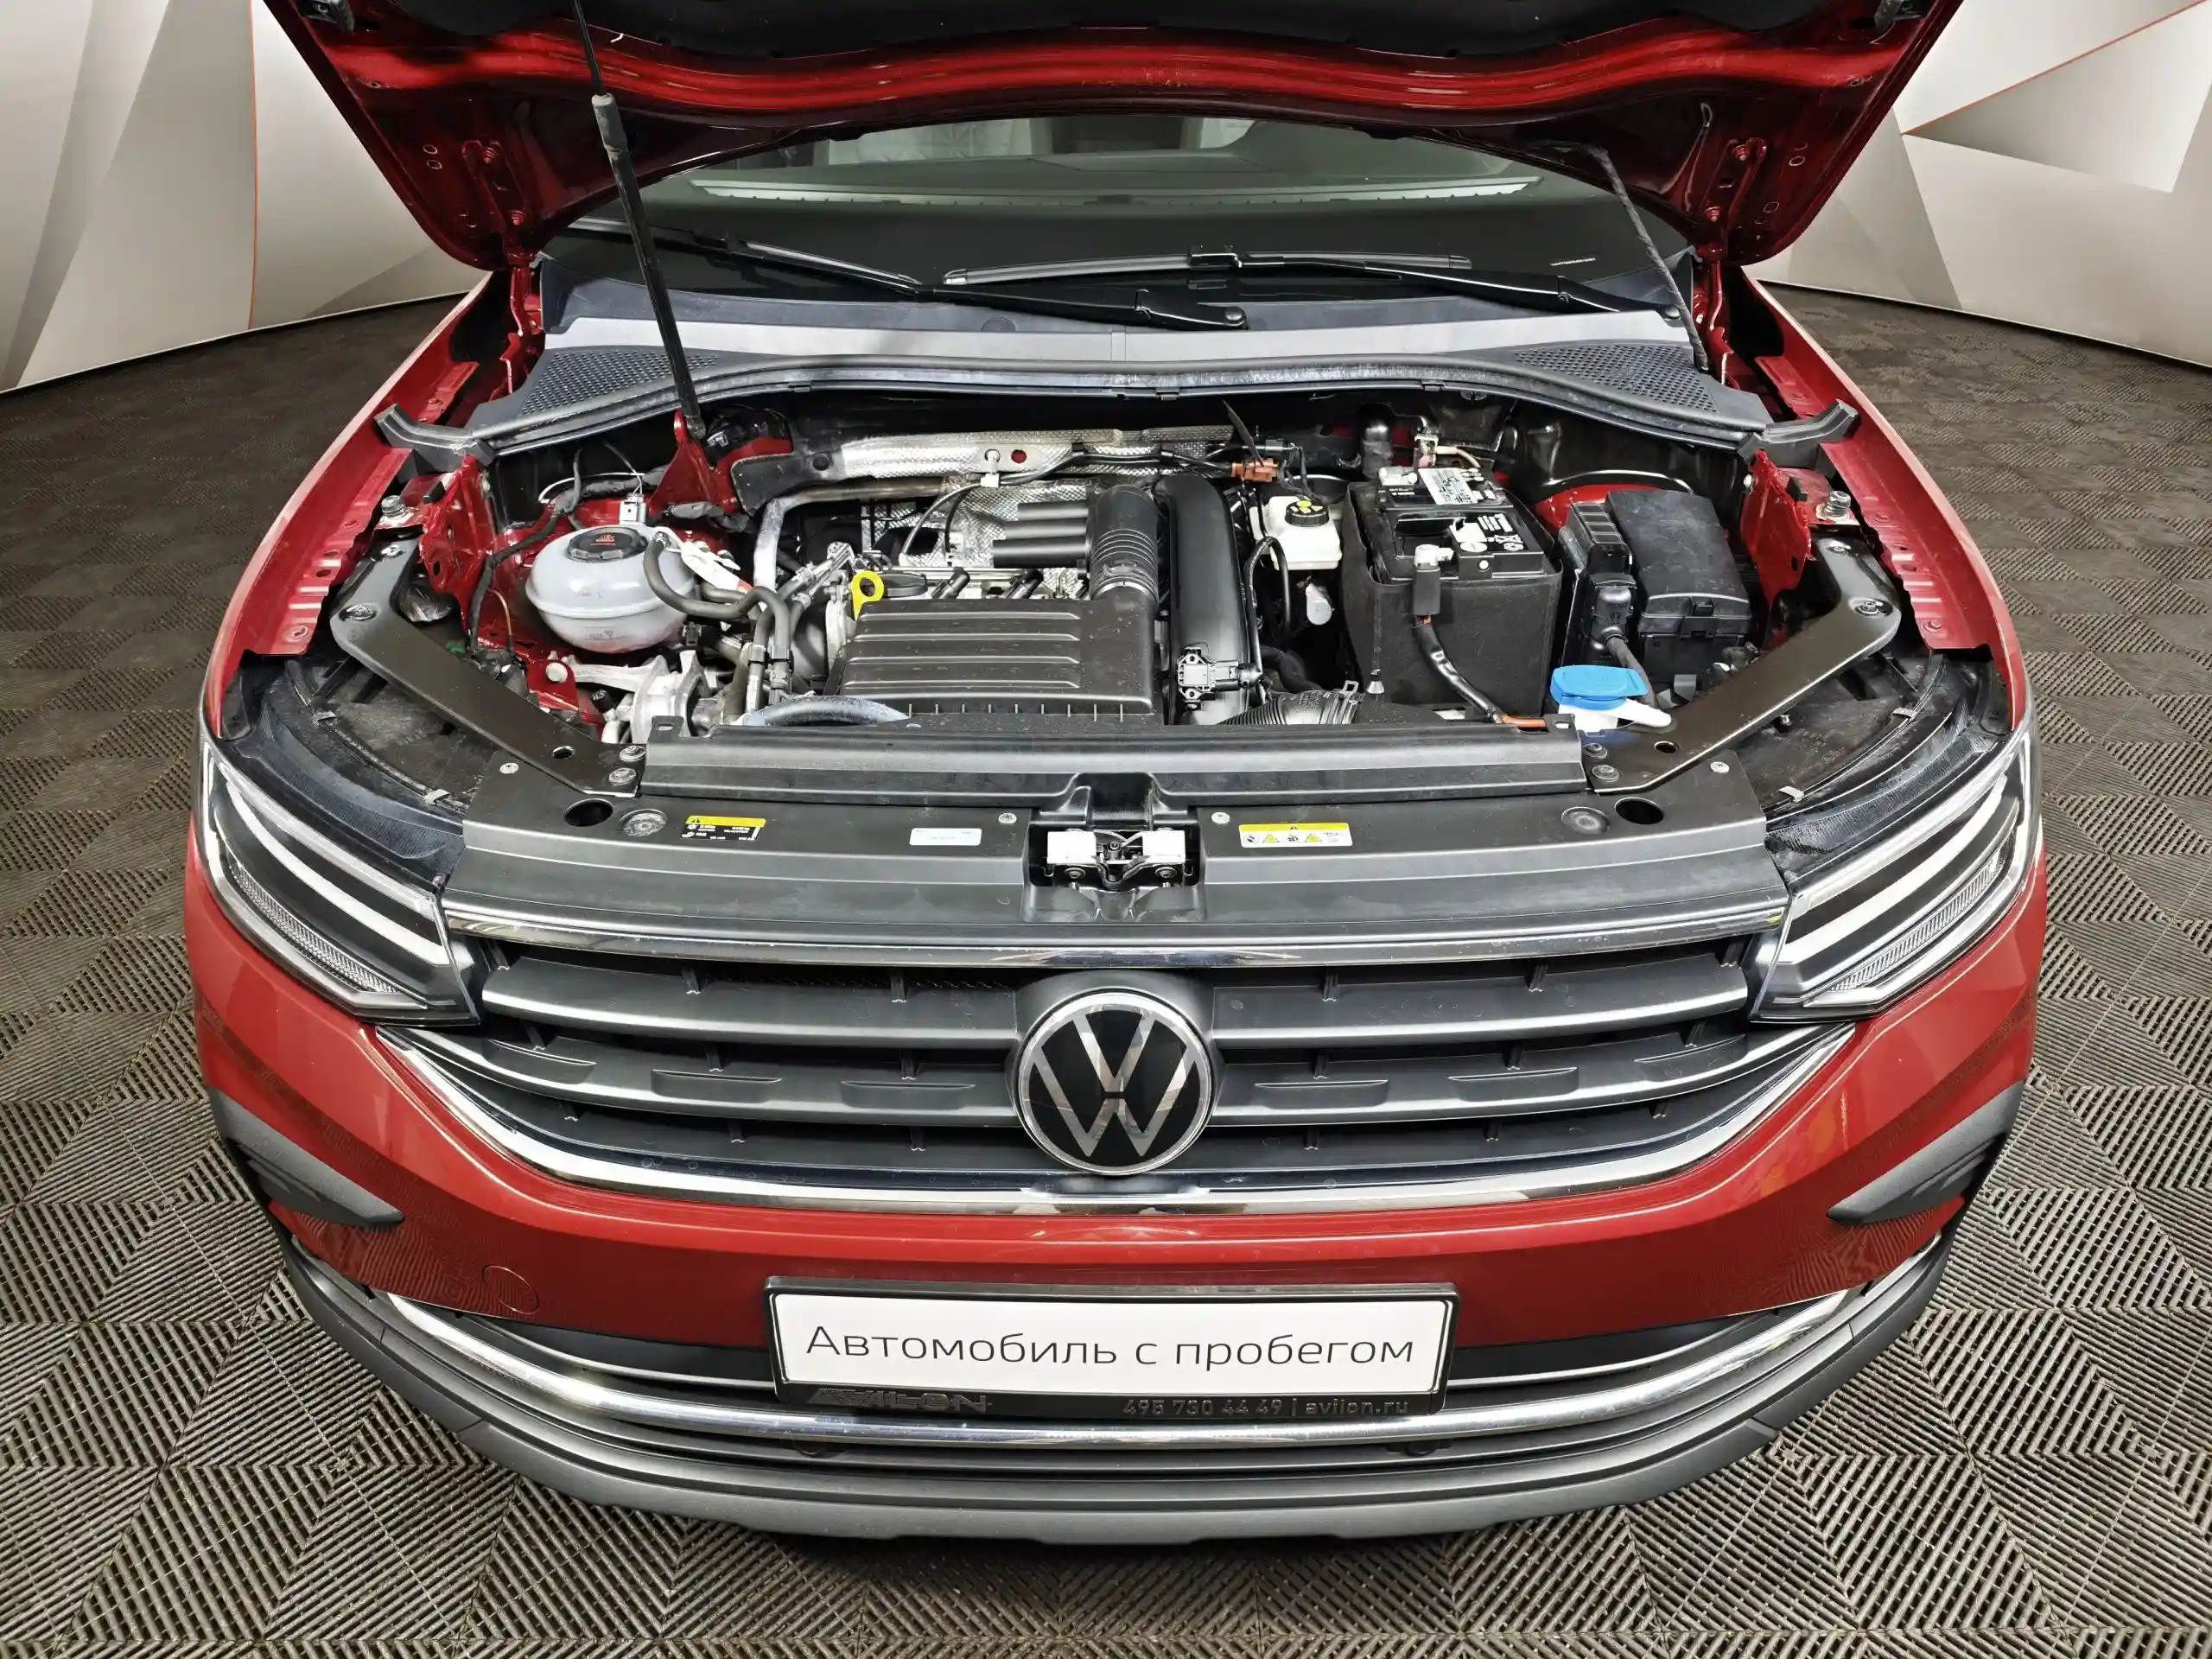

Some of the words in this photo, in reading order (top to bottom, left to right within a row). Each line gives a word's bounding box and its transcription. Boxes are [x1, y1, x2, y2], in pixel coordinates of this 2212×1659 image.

[806, 1325, 1117, 1364] Автомобиль
[1135, 1343, 1158, 1365] с
[1176, 1333, 1413, 1372] пробегом
[805, 1388, 990, 1414] AVILON
[1122, 1398, 1166, 1416] 495
[1172, 1399, 1213, 1415] 730
[1220, 1399, 1249, 1415] 44
[1255, 1398, 1284, 1415] 49
[1304, 1397, 1409, 1415] avilon.ru
